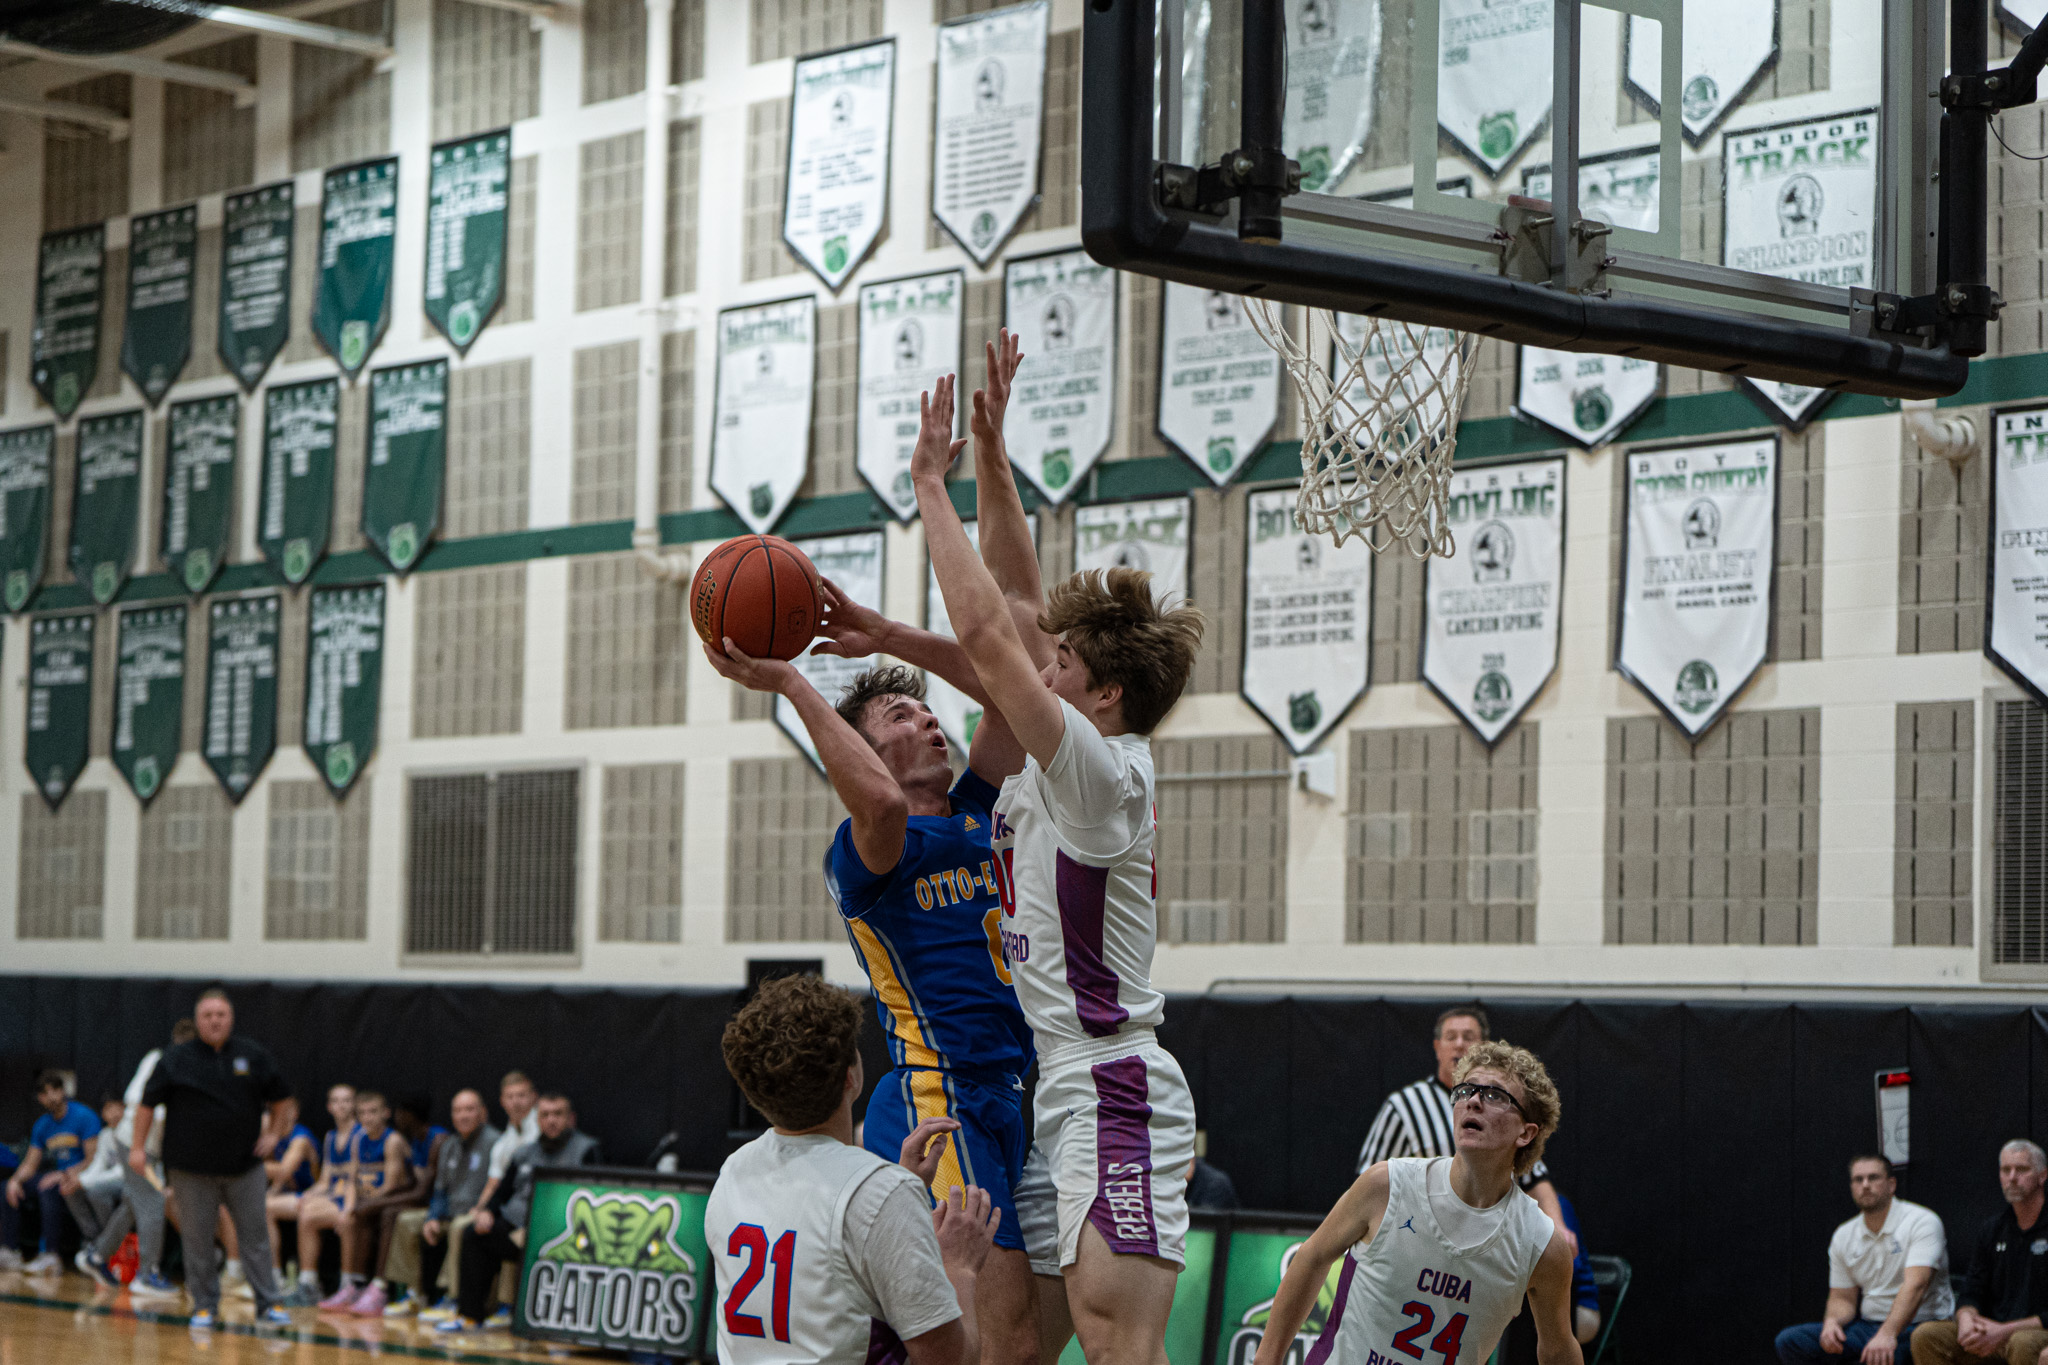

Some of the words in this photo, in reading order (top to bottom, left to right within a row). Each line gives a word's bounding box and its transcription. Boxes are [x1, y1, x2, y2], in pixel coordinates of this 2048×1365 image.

[1736, 120, 1869, 154] INDOOR
[1735, 136, 1871, 184] TRACK
[1732, 230, 1868, 269] CHAMPION
[1449, 484, 1556, 524] OWLING
[1643, 548, 1757, 586] FINALIST
[1447, 615, 1499, 636] CAMERON
[1502, 611, 1544, 632] SPRING
[915, 860, 999, 911] OTTO-E
[1104, 1163, 1150, 1240] REBELS
[525, 1260, 697, 1345] GATORS
[724, 1222, 797, 1344] 21
[1417, 1267, 1473, 1304] CUBA
[1391, 1300, 1470, 1365] 24
